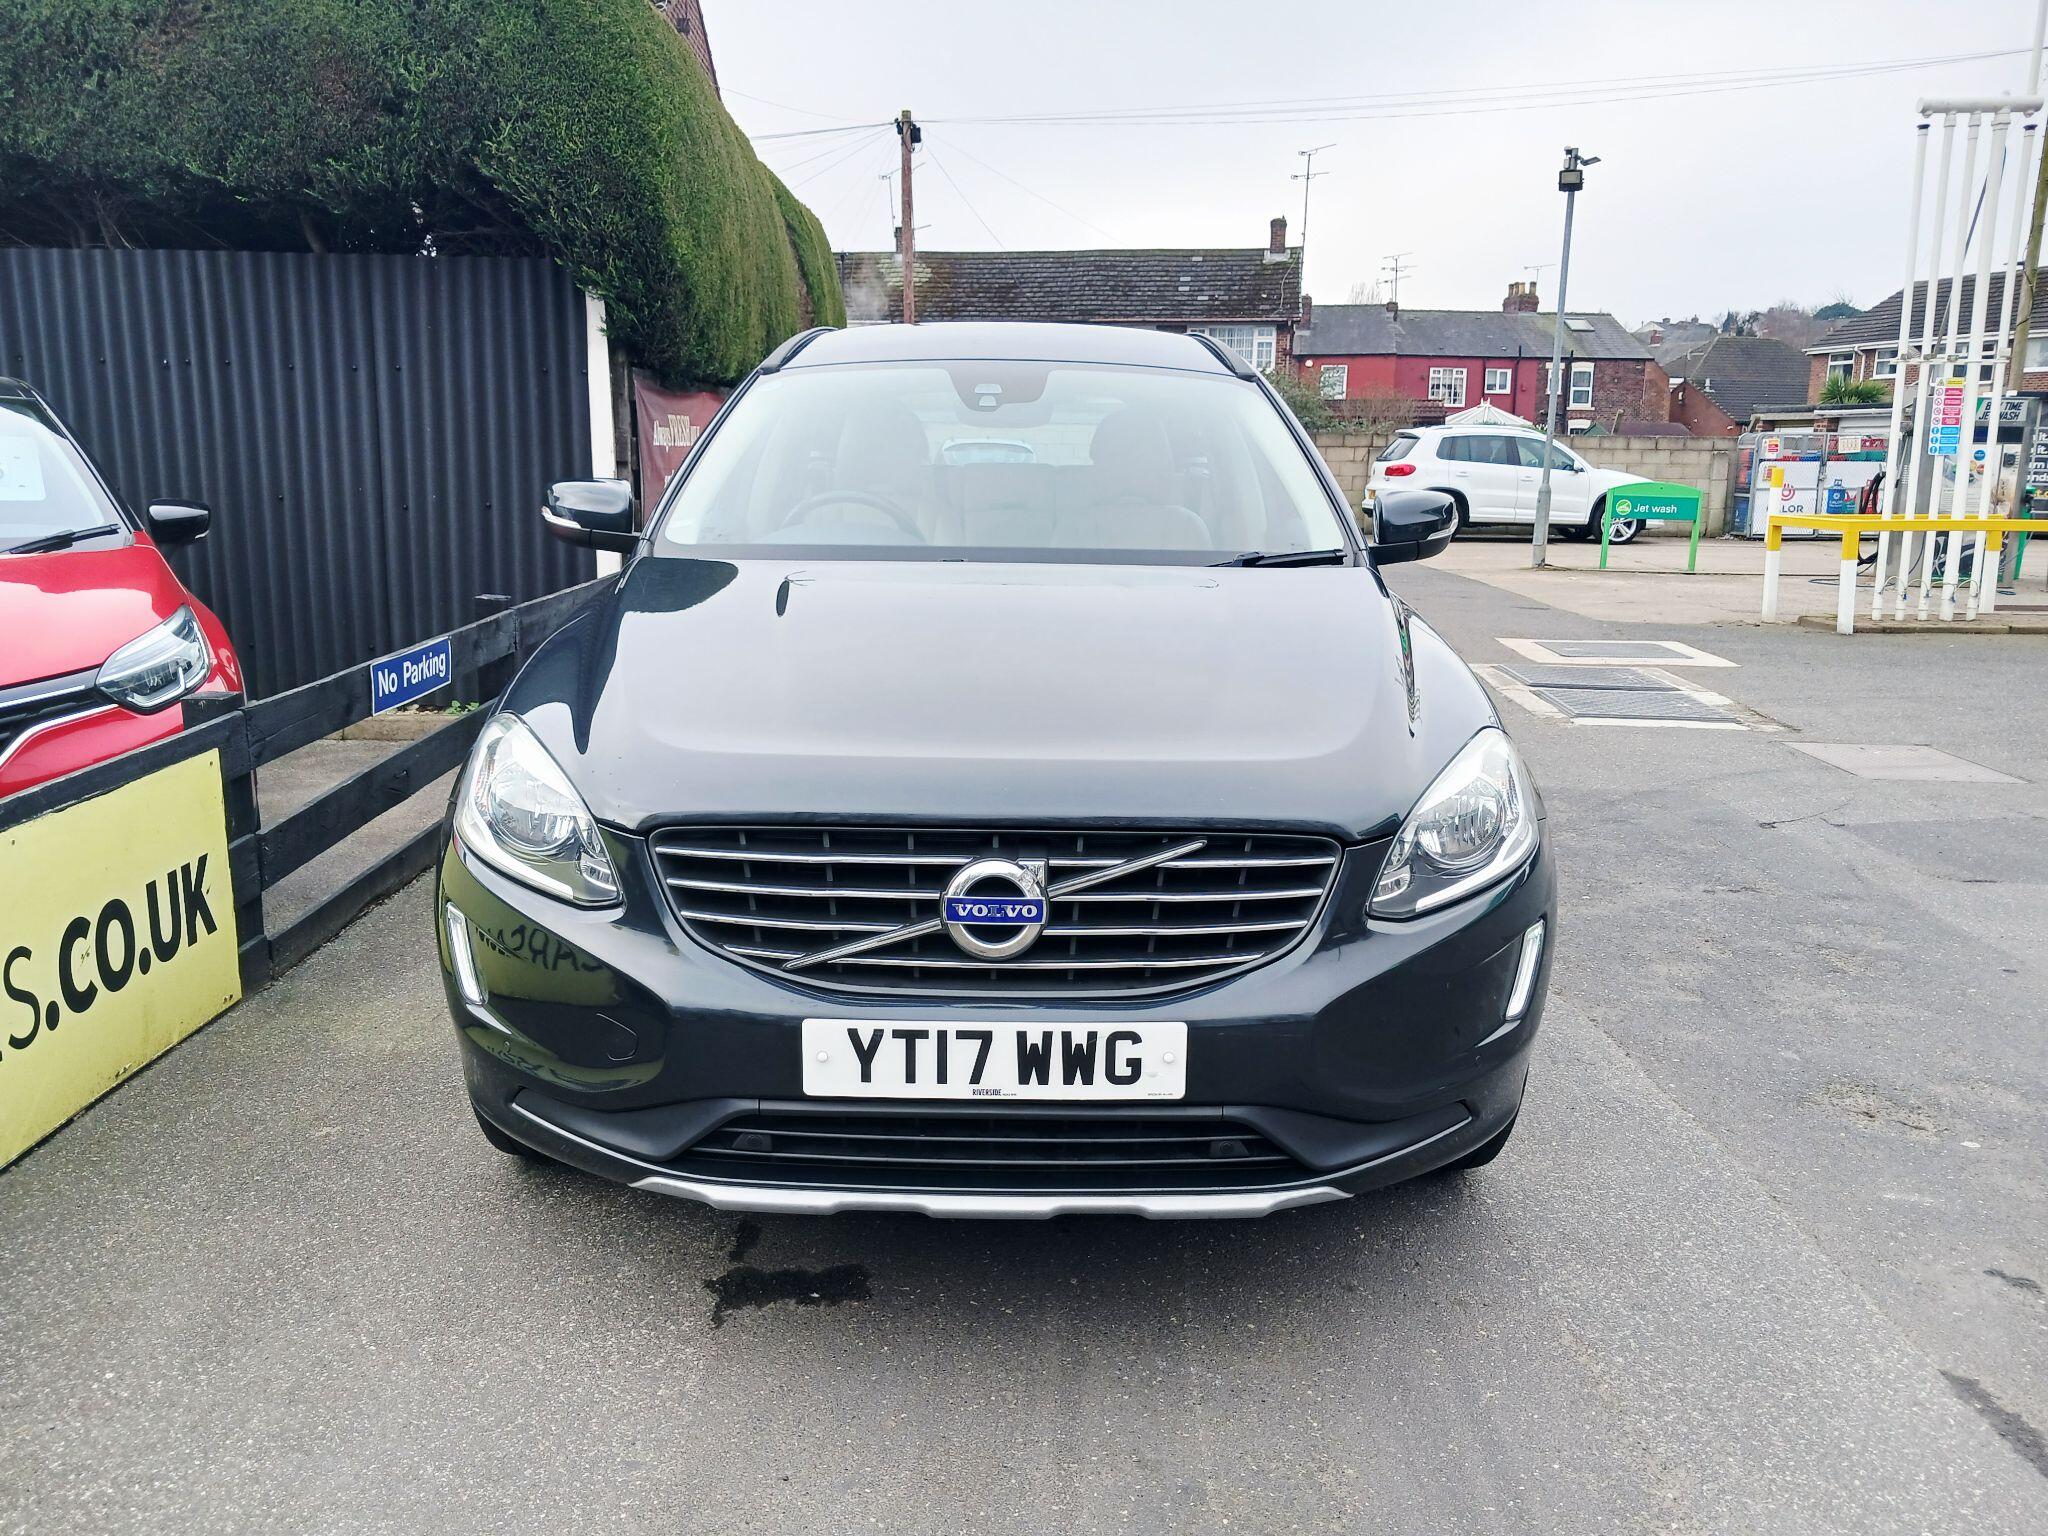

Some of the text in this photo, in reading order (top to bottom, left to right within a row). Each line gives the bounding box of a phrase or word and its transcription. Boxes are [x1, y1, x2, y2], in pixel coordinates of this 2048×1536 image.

[2004, 402, 2024, 410] TIME
[1999, 411, 2019, 420] WASH
[1633, 503, 1677, 514] Jet wash
[377, 651, 446, 698] No Parking
[951, 903, 1038, 918] VOLVO
[0, 852, 218, 1062] S.CO.UK
[846, 1027, 1143, 1086] YT17 WWG
[972, 1088, 1002, 1096] RIVERSIDE
